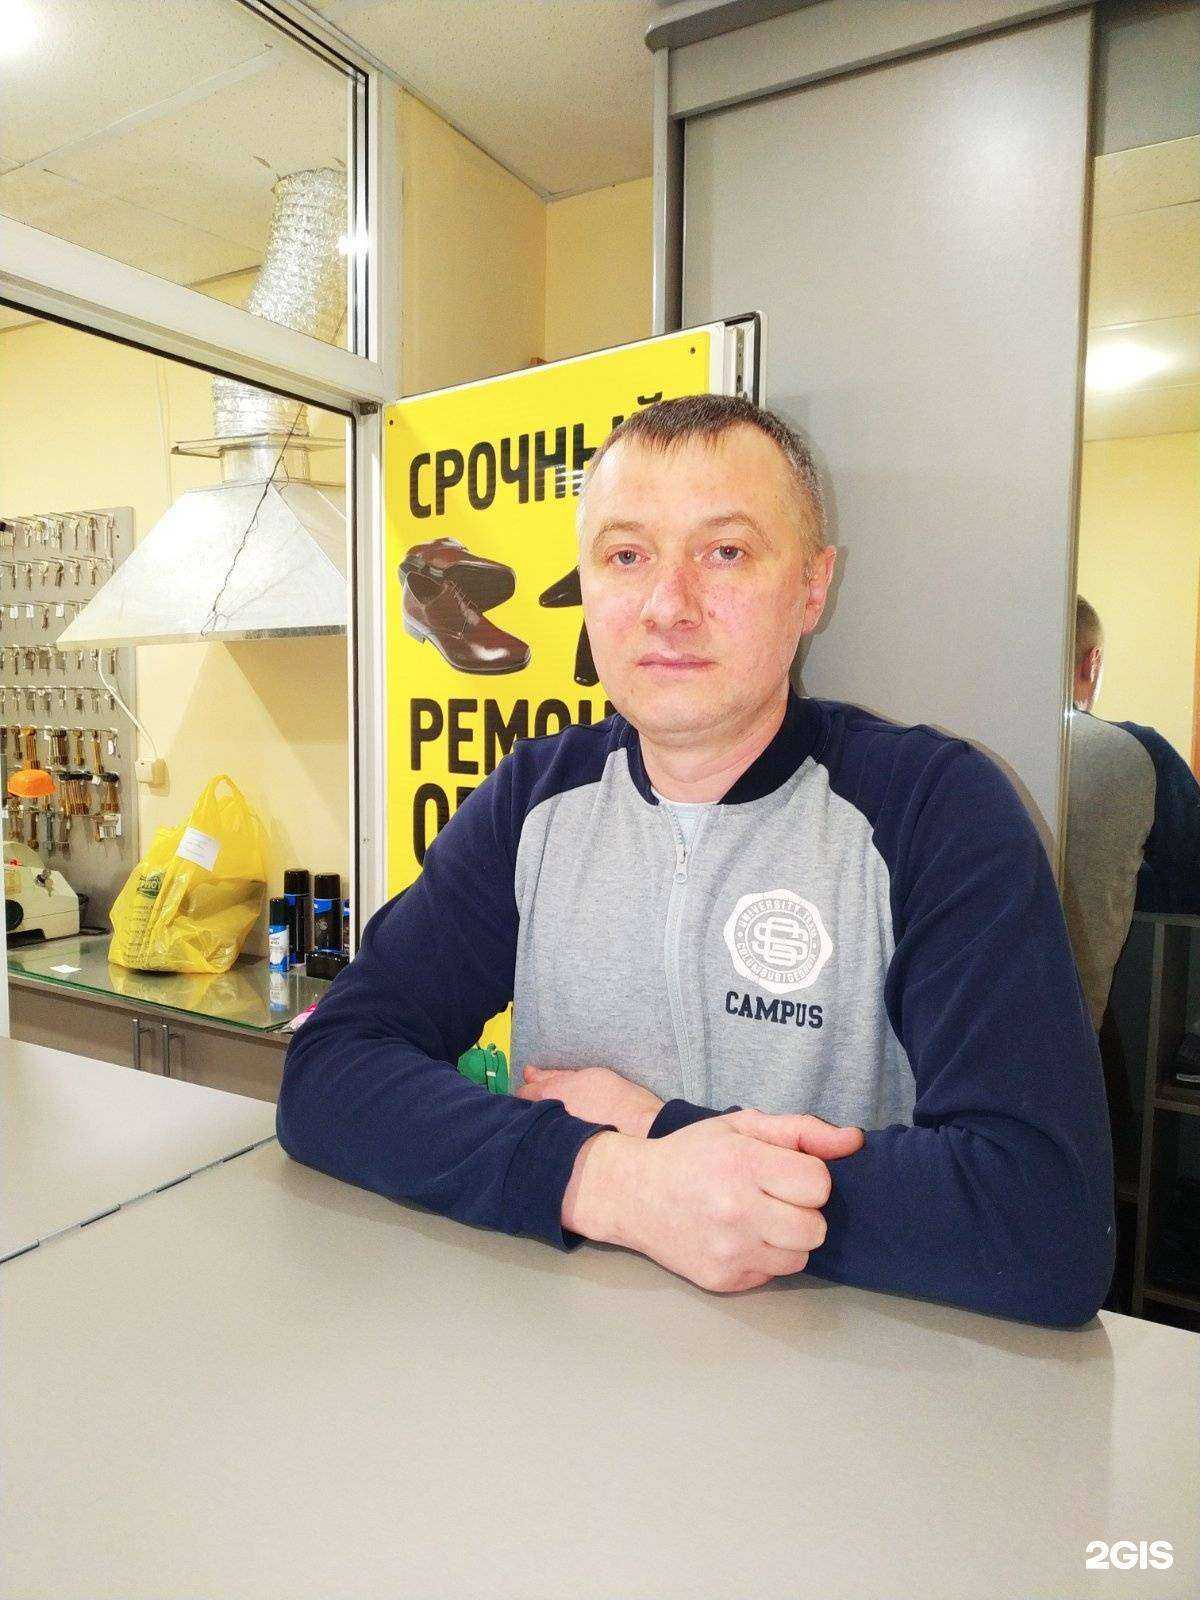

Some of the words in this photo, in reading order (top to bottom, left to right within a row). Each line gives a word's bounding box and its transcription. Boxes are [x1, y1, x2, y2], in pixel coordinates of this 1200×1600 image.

[409, 392, 662, 518] СРОЧН
[738, 899, 801, 928] UNIVERSITY
[725, 990, 823, 1029] CAMPUS
